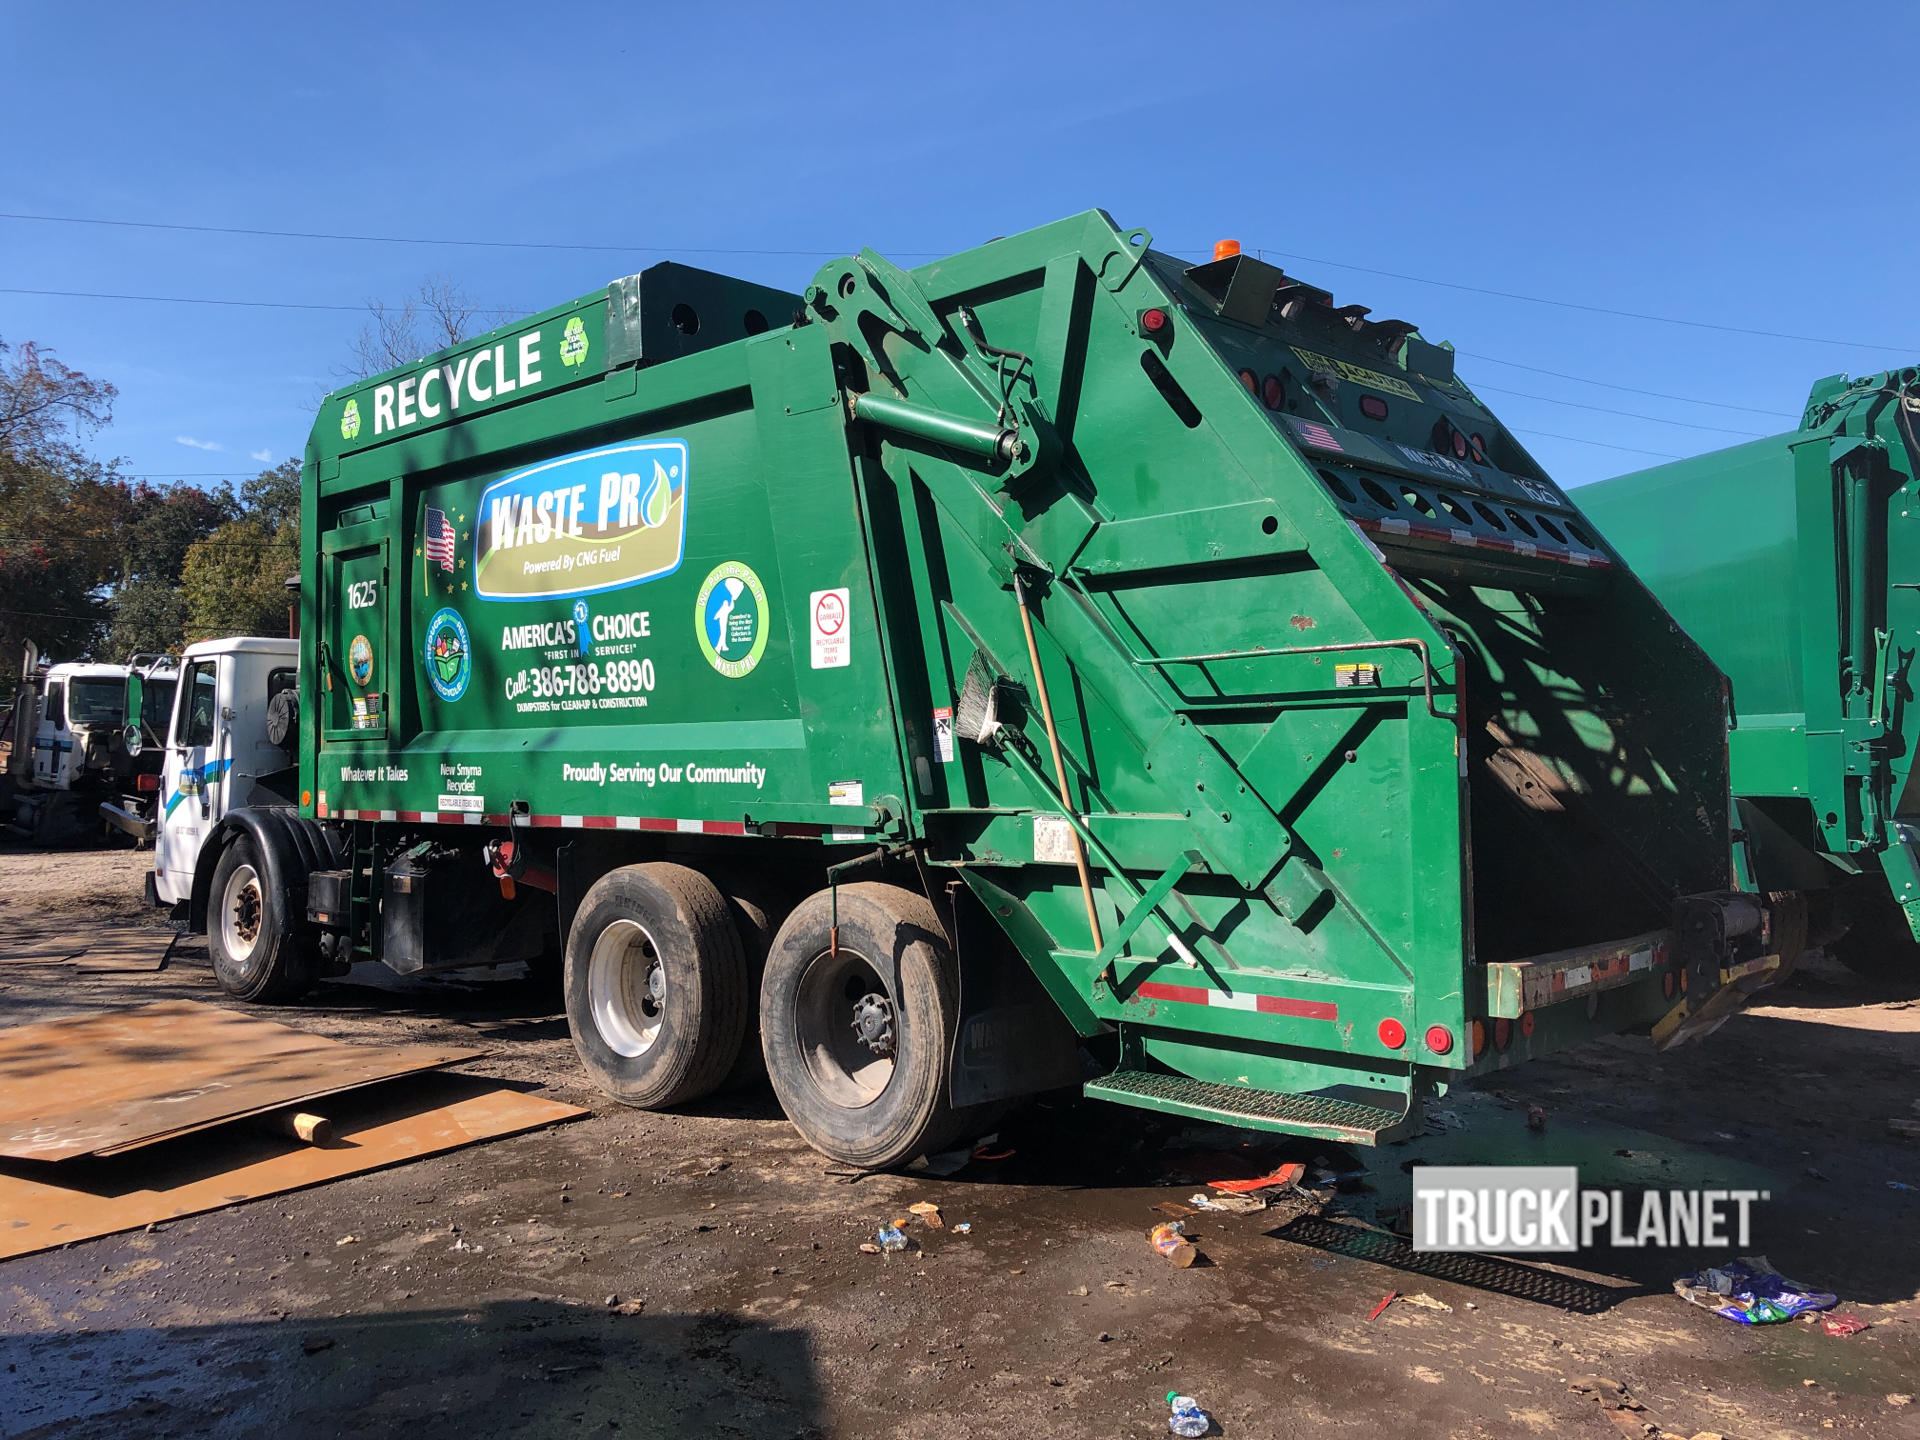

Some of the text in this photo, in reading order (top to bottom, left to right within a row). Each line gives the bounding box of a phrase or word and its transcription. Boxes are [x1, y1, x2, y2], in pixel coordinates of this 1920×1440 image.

[374, 331, 542, 435] RECYCLE
[491, 484, 587, 551] WASTE
[523, 546, 621, 575] Powered By CNG Fuel
[743, 568, 756, 588] Pro
[347, 579, 377, 609] 1625
[502, 611, 651, 650] AMERICA'S CHOICE
[816, 636, 845, 646] RECYCLABLE
[824, 646, 838, 655] ITEMS
[570, 648, 580, 659] IN
[823, 656, 838, 664] ONLY
[714, 655, 756, 677] WASTE PRO
[433, 678, 463, 697] RECYCLE
[505, 658, 655, 700] Call: 386-788-8890
[516, 696, 647, 712] DUMPSTERS for CLEAN-UP & CONSTRUCTION
[341, 765, 408, 782] Whatever It Takes
[440, 763, 482, 779] New Smyrna
[563, 761, 766, 789] Proudly Serving Our Community
[446, 779, 476, 795] Recycles!
[473, 799, 483, 809] ONLY
